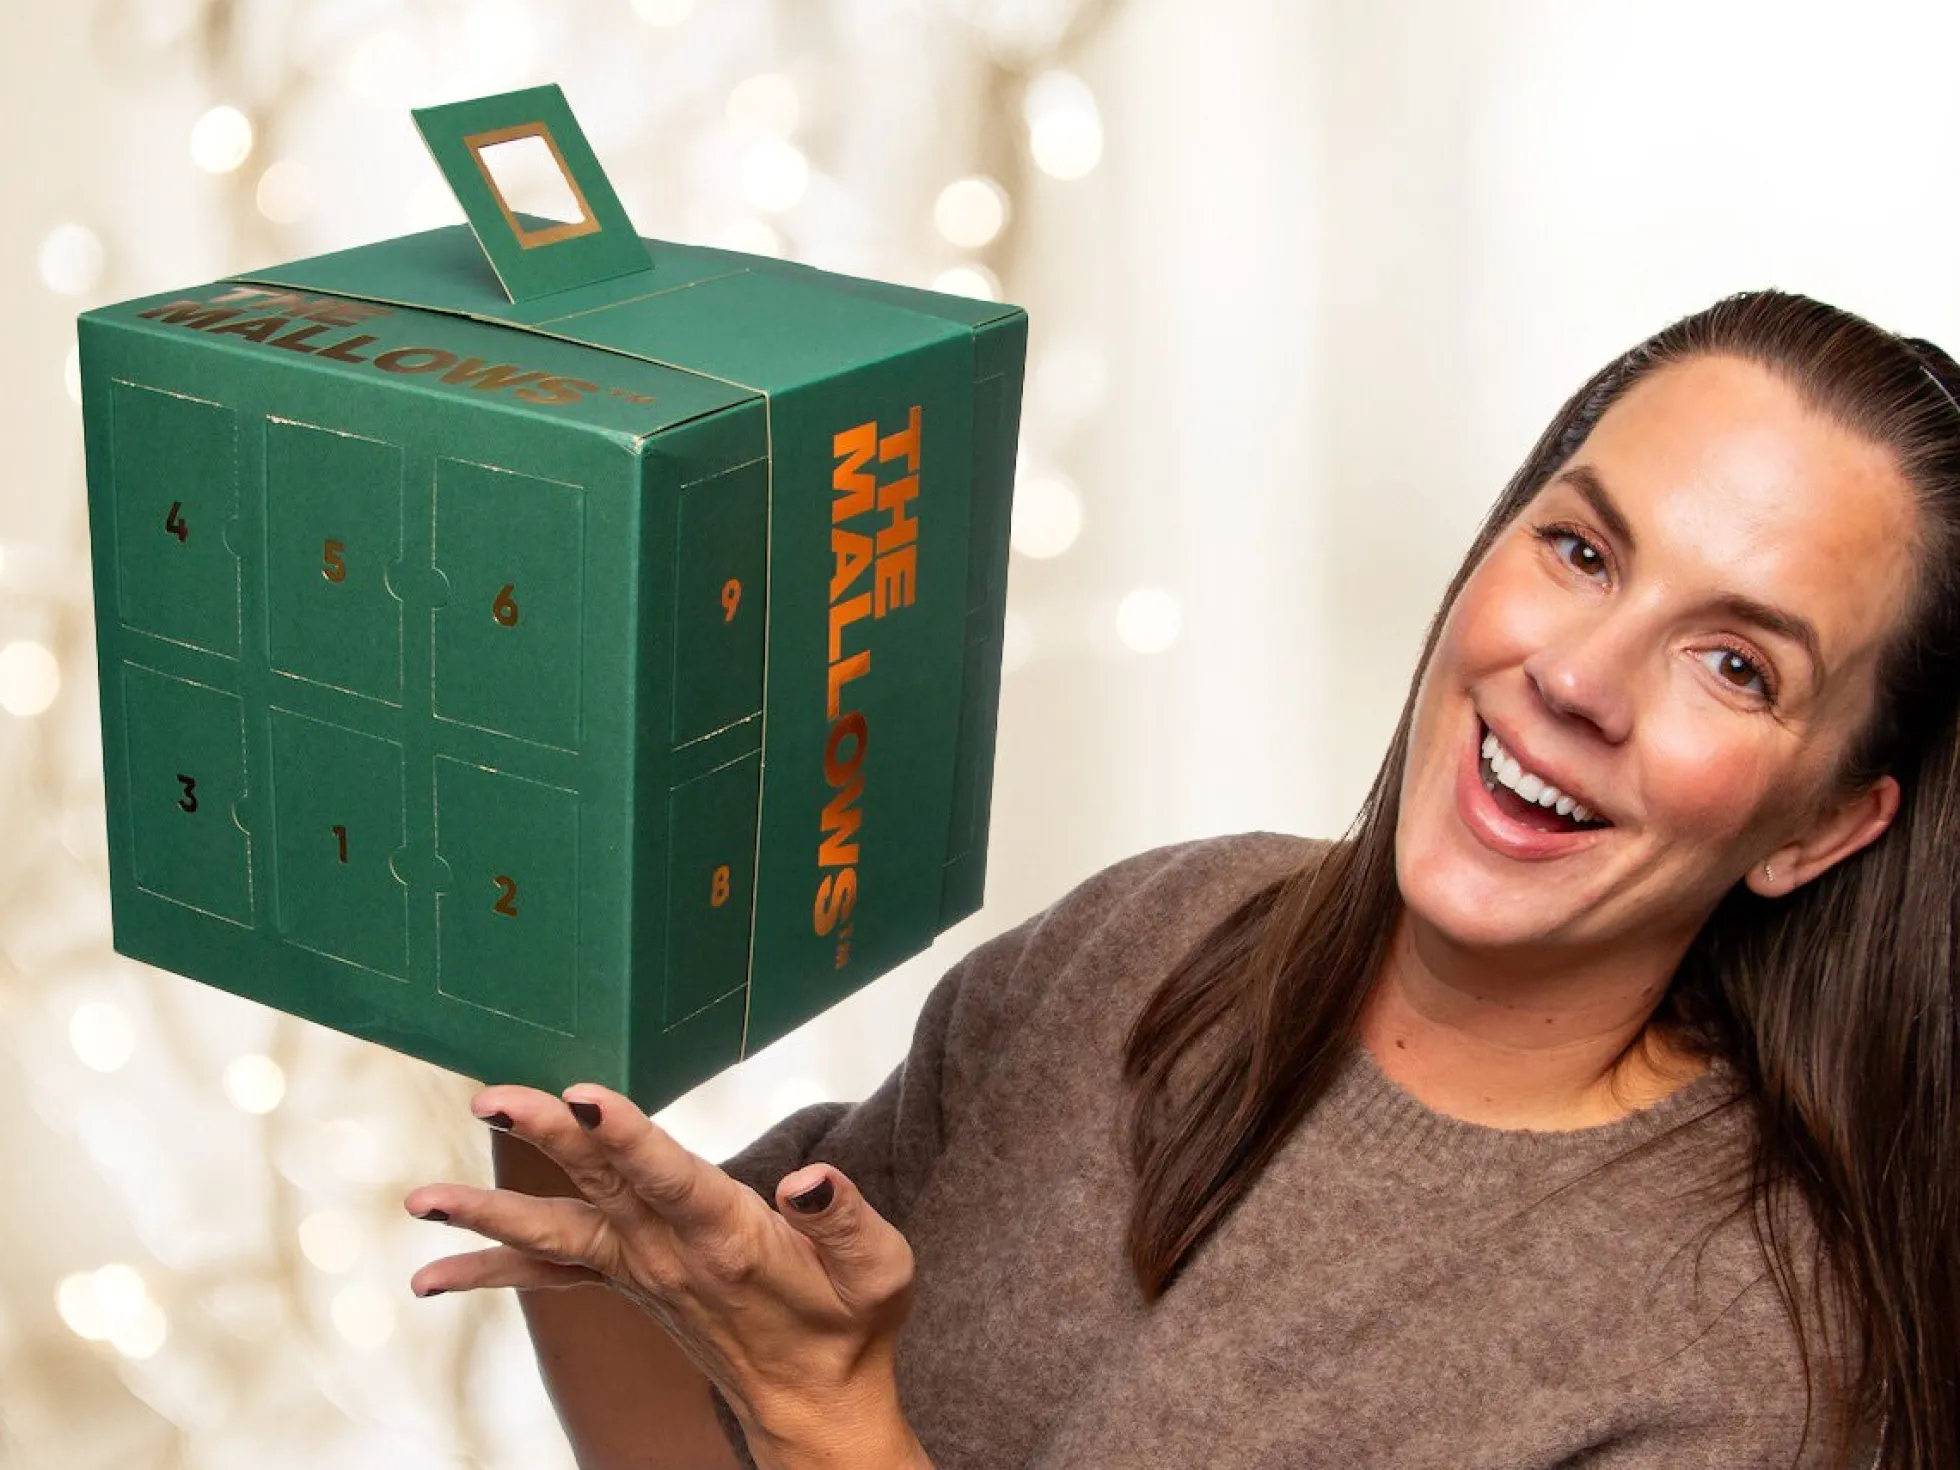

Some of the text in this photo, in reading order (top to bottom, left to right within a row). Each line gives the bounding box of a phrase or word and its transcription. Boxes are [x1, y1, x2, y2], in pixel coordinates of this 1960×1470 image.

[209, 286, 393, 327] THE
[165, 501, 189, 543] 4
[873, 405, 922, 620] THE
[321, 540, 347, 584] 5
[492, 583, 519, 628] 6
[720, 577, 743, 624] 9
[176, 774, 199, 814] 3
[332, 825, 348, 864] 1
[493, 875, 518, 918] 2
[710, 863, 731, 908] 8
